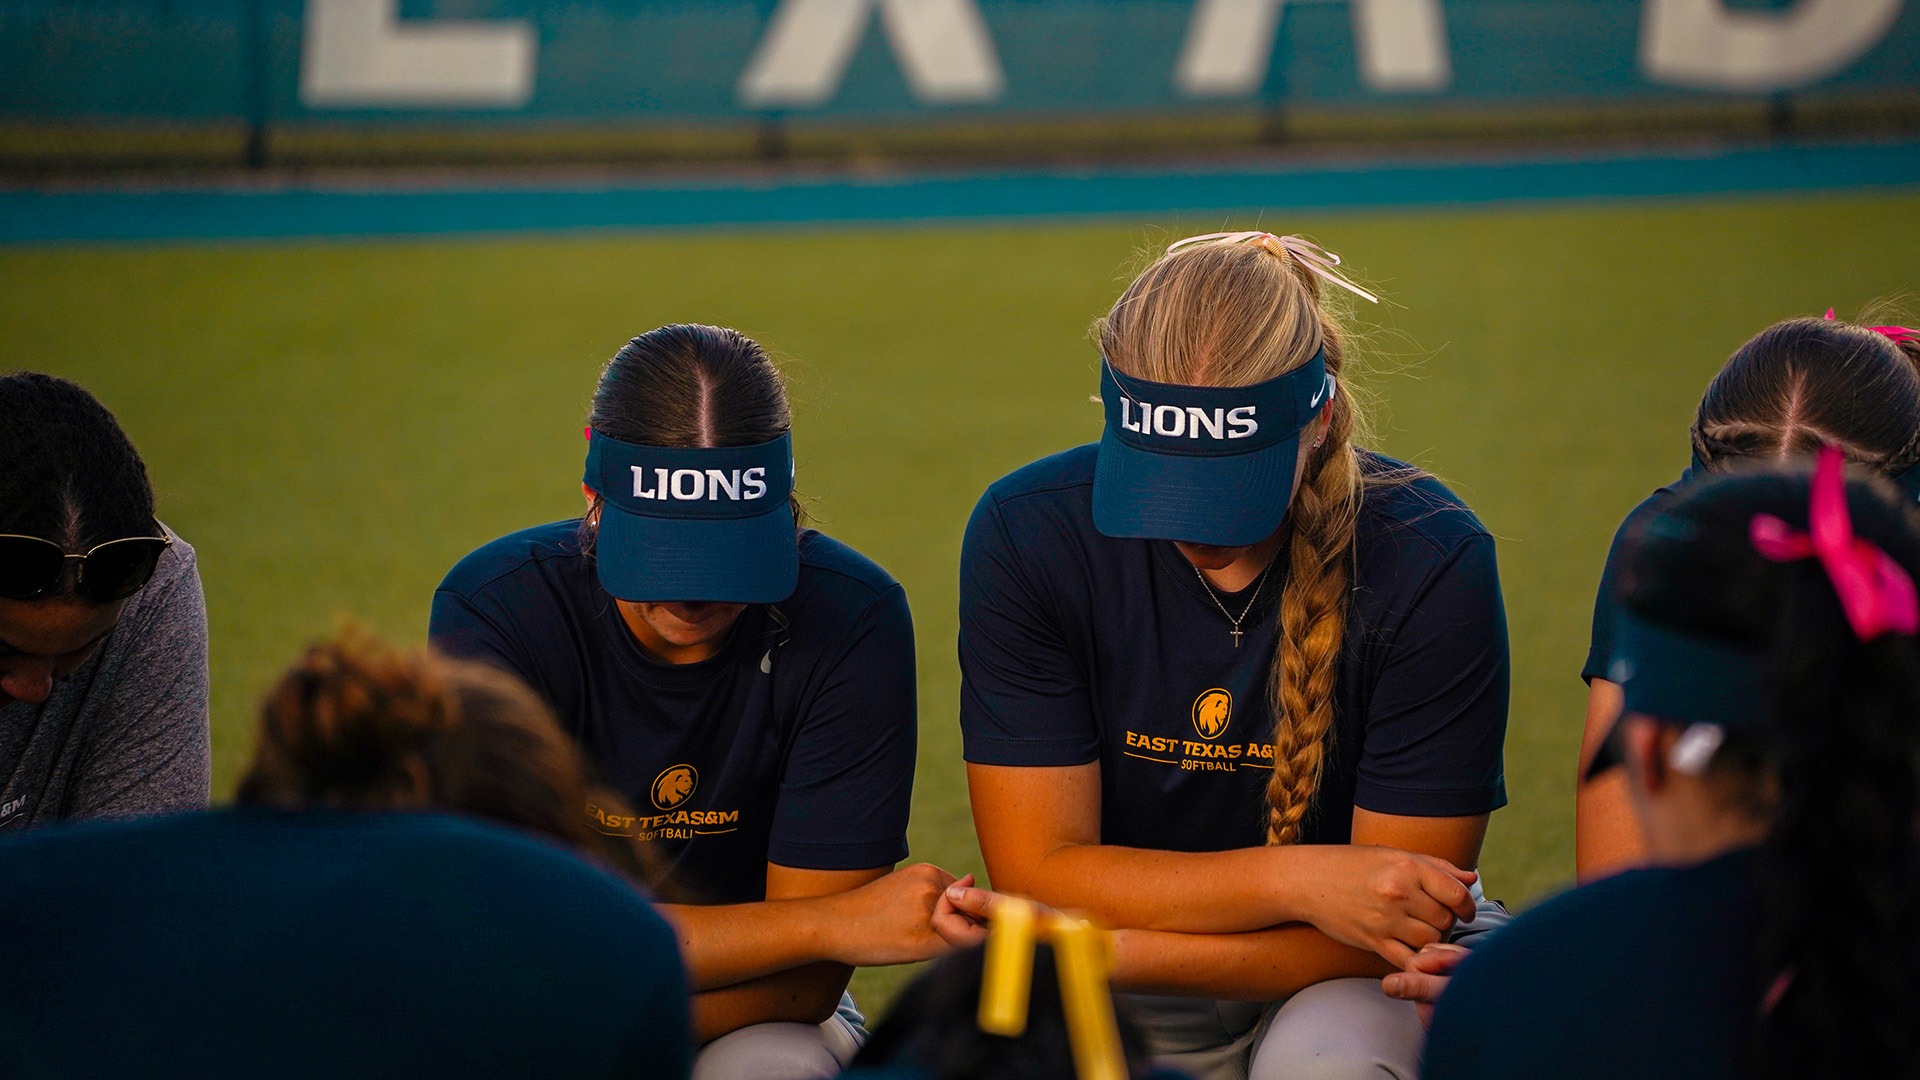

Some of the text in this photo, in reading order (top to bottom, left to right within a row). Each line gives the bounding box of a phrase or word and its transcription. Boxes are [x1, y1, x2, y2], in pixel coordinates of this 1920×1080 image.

[1120, 396, 1259, 440] LIONS
[630, 465, 767, 501] LIONS
[1125, 731, 1179, 753] EAST
[1182, 740, 1242, 759] TEXAS
[1180, 758, 1237, 772] SOFTBALL
[0, 794, 26, 818] &M
[584, 803, 636, 829] EAST
